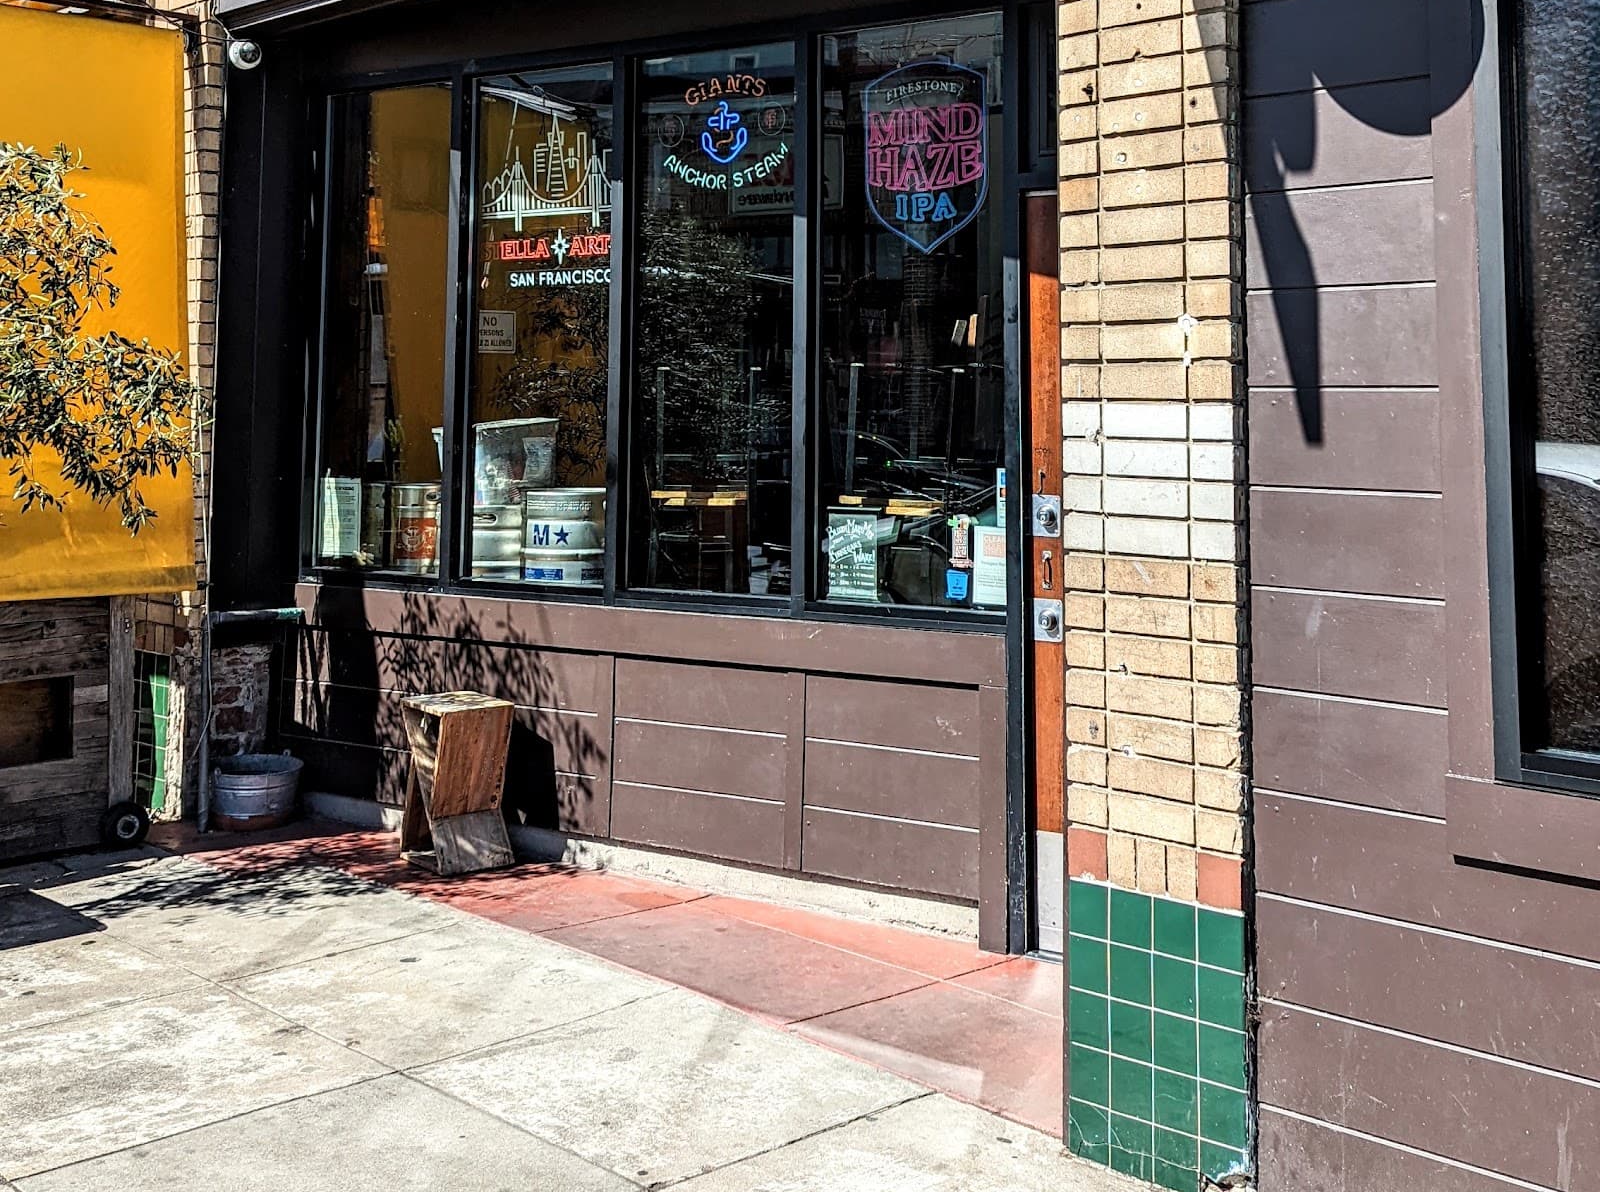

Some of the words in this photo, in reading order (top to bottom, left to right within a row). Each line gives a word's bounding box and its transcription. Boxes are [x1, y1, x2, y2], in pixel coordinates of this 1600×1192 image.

[685, 74, 766, 105] GIANTS
[869, 103, 983, 146] MIND
[663, 154, 727, 190] ANCHOR
[732, 142, 789, 187] STEAM
[868, 141, 984, 192] HAZE
[895, 192, 957, 222] IPA
[569, 234, 611, 257] ART
[510, 272, 535, 287] SAN
[482, 316, 497, 326] NO
[533, 524, 550, 546] M
